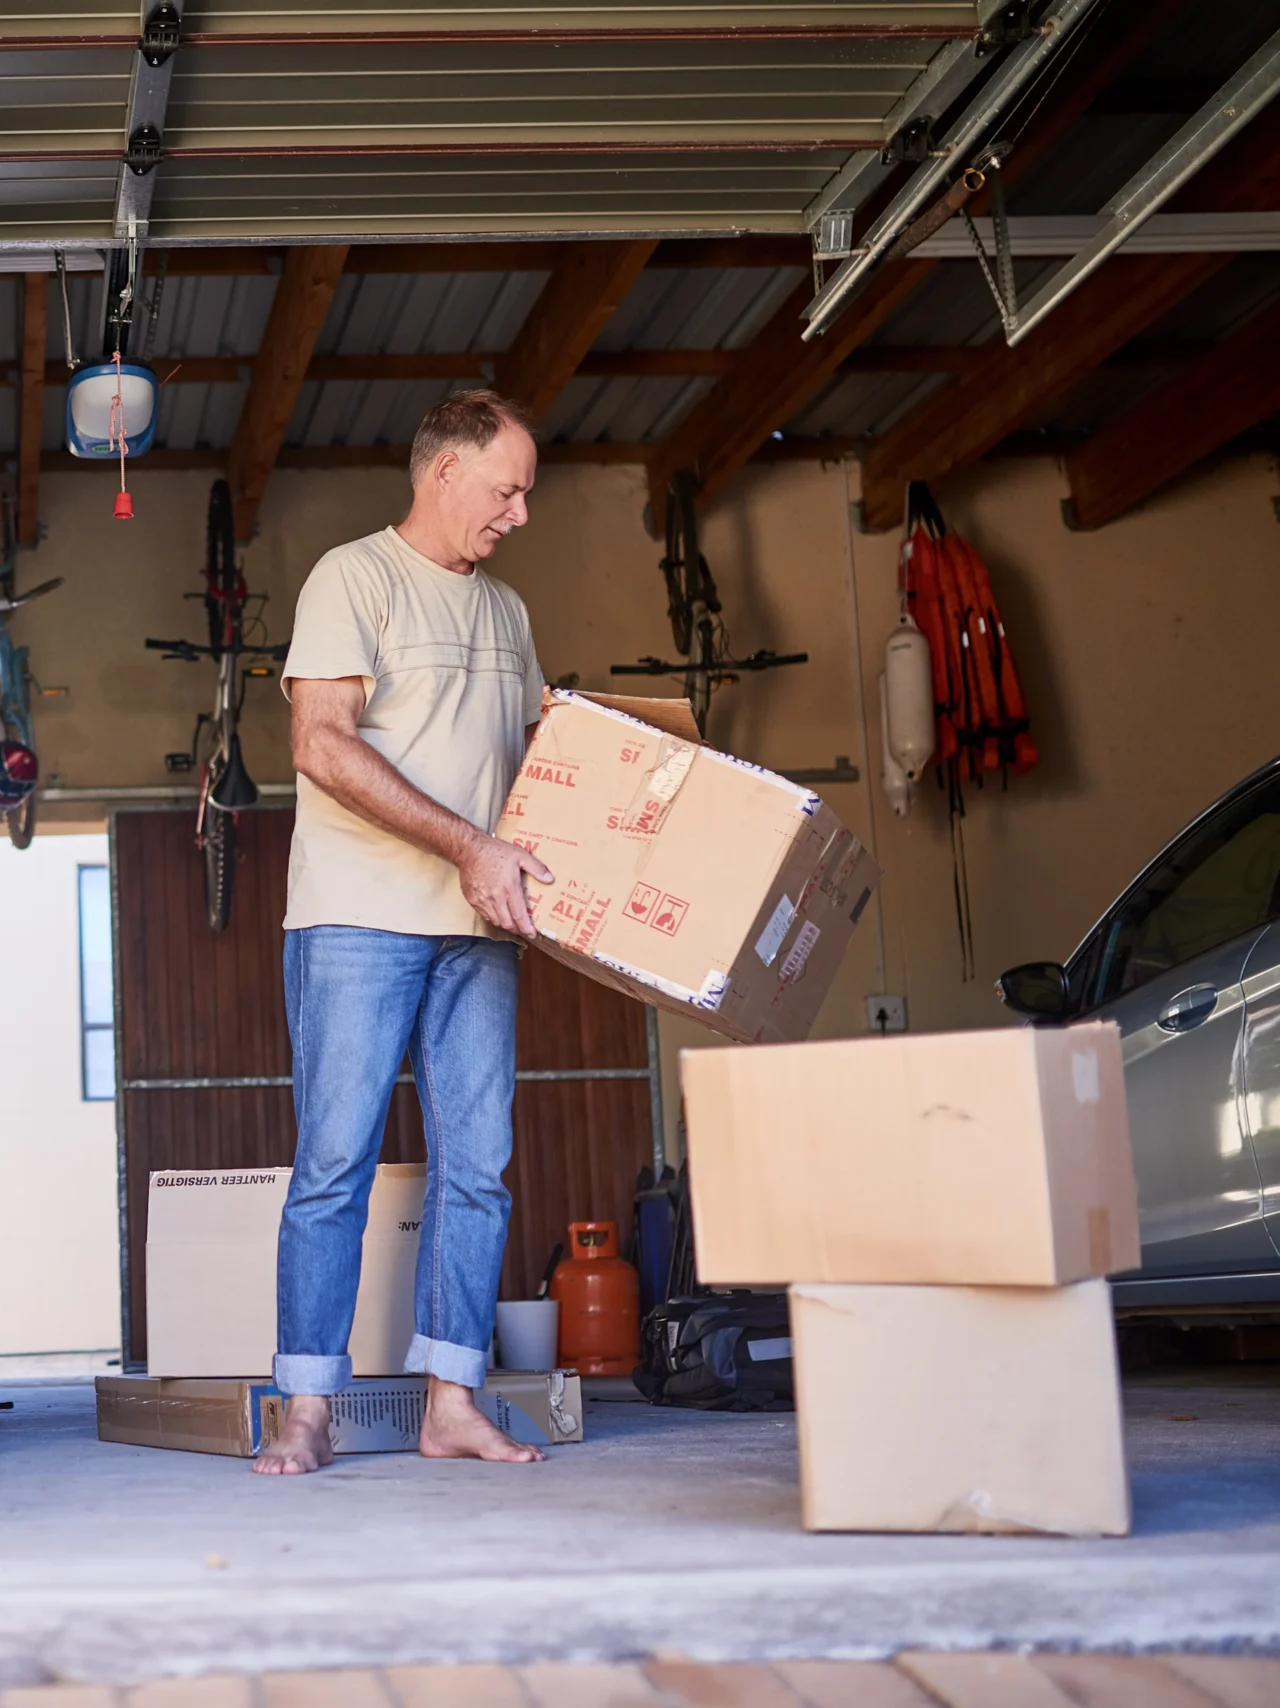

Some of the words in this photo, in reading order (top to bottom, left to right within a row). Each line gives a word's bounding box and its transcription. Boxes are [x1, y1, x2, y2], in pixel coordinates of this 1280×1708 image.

[156, 1176, 218, 1188] VERSIGTIG
[221, 1174, 277, 1186] HANTEER
[397, 1221, 423, 1232] AN:
